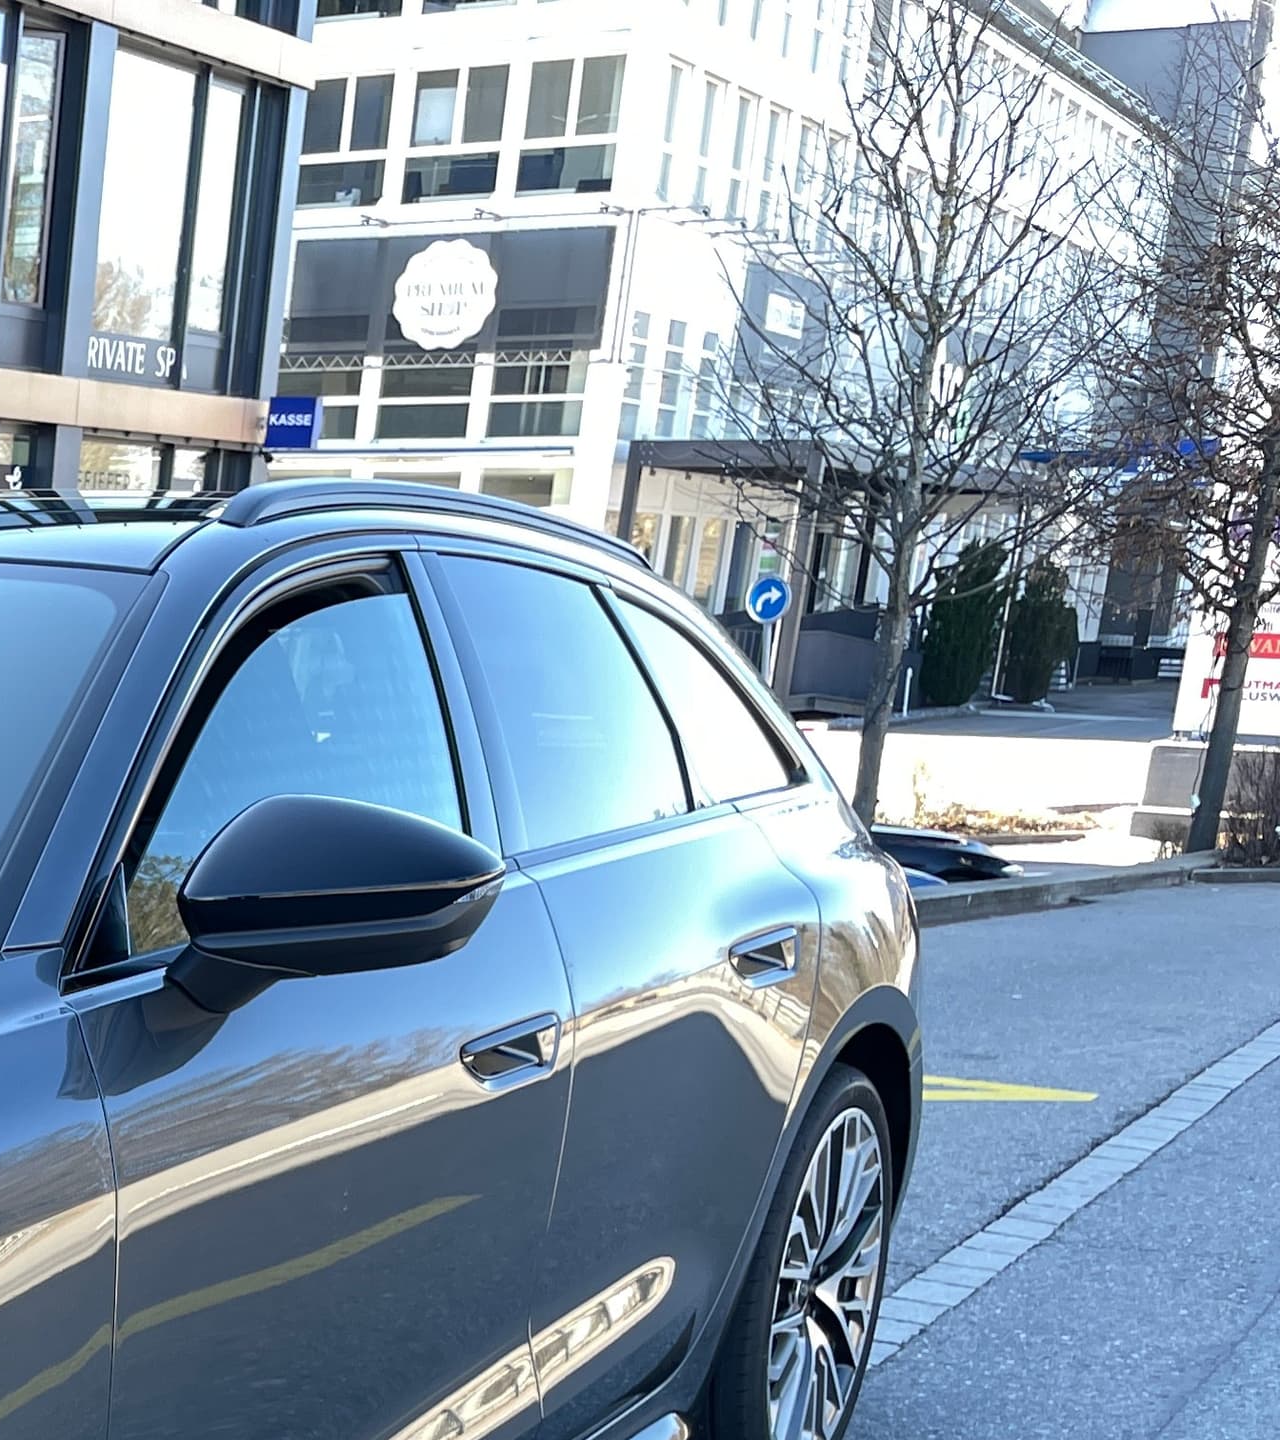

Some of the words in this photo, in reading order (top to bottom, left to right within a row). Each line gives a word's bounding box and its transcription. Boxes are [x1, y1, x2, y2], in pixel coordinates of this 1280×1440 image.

[87, 336, 146, 375] RIVATE
[154, 345, 187, 379] SP
[269, 413, 313, 427] KASSE
